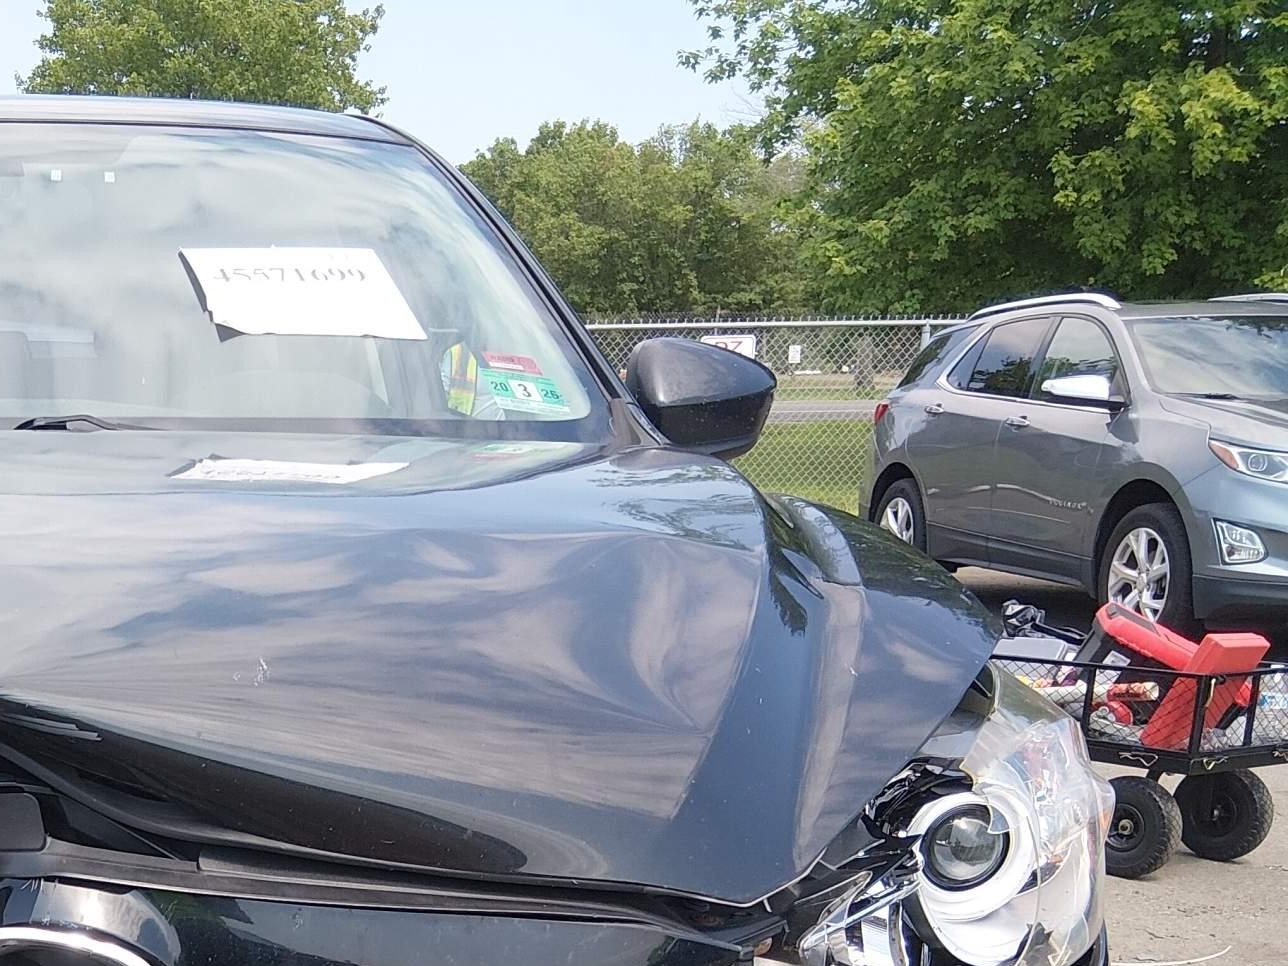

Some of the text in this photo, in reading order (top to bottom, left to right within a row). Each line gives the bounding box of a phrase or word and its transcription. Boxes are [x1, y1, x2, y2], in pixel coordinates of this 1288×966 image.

[213, 268, 366, 282] 45571699
[490, 381, 560, 400] 20 3 26
